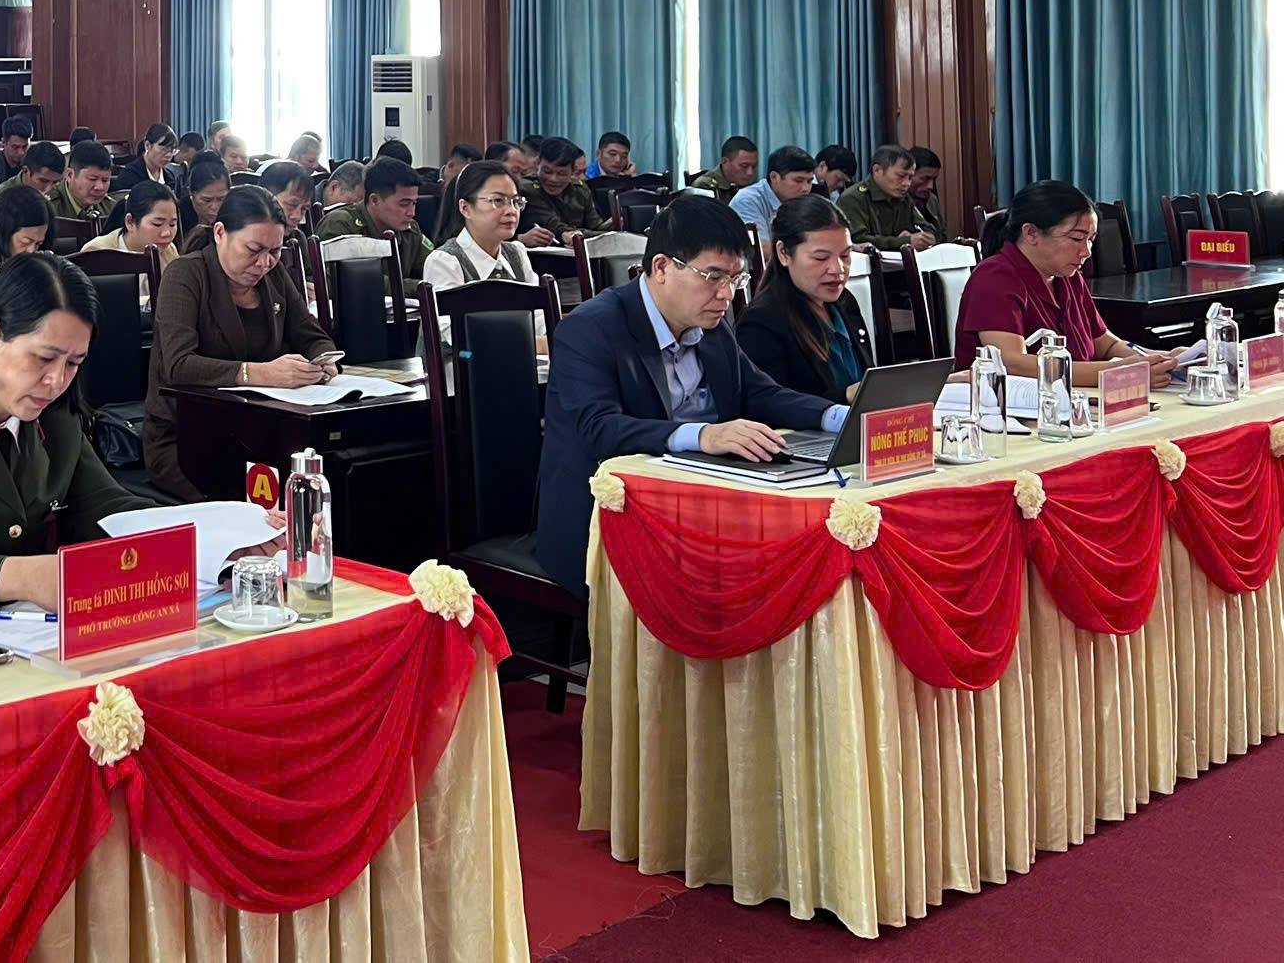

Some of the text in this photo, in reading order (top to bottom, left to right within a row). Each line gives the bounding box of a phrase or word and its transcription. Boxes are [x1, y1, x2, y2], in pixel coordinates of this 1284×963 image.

[253, 474, 273, 502] A
[67, 596, 93, 614] Trung
[94, 587, 103, 607] tá
[104, 584, 127, 607] ĐINH
[128, 581, 145, 602] THỊ
[78, 621, 96, 636] PHÓ
[132, 607, 156, 625] CÔNG
[156, 605, 171, 618] AN
[168, 601, 180, 615] XÃ
